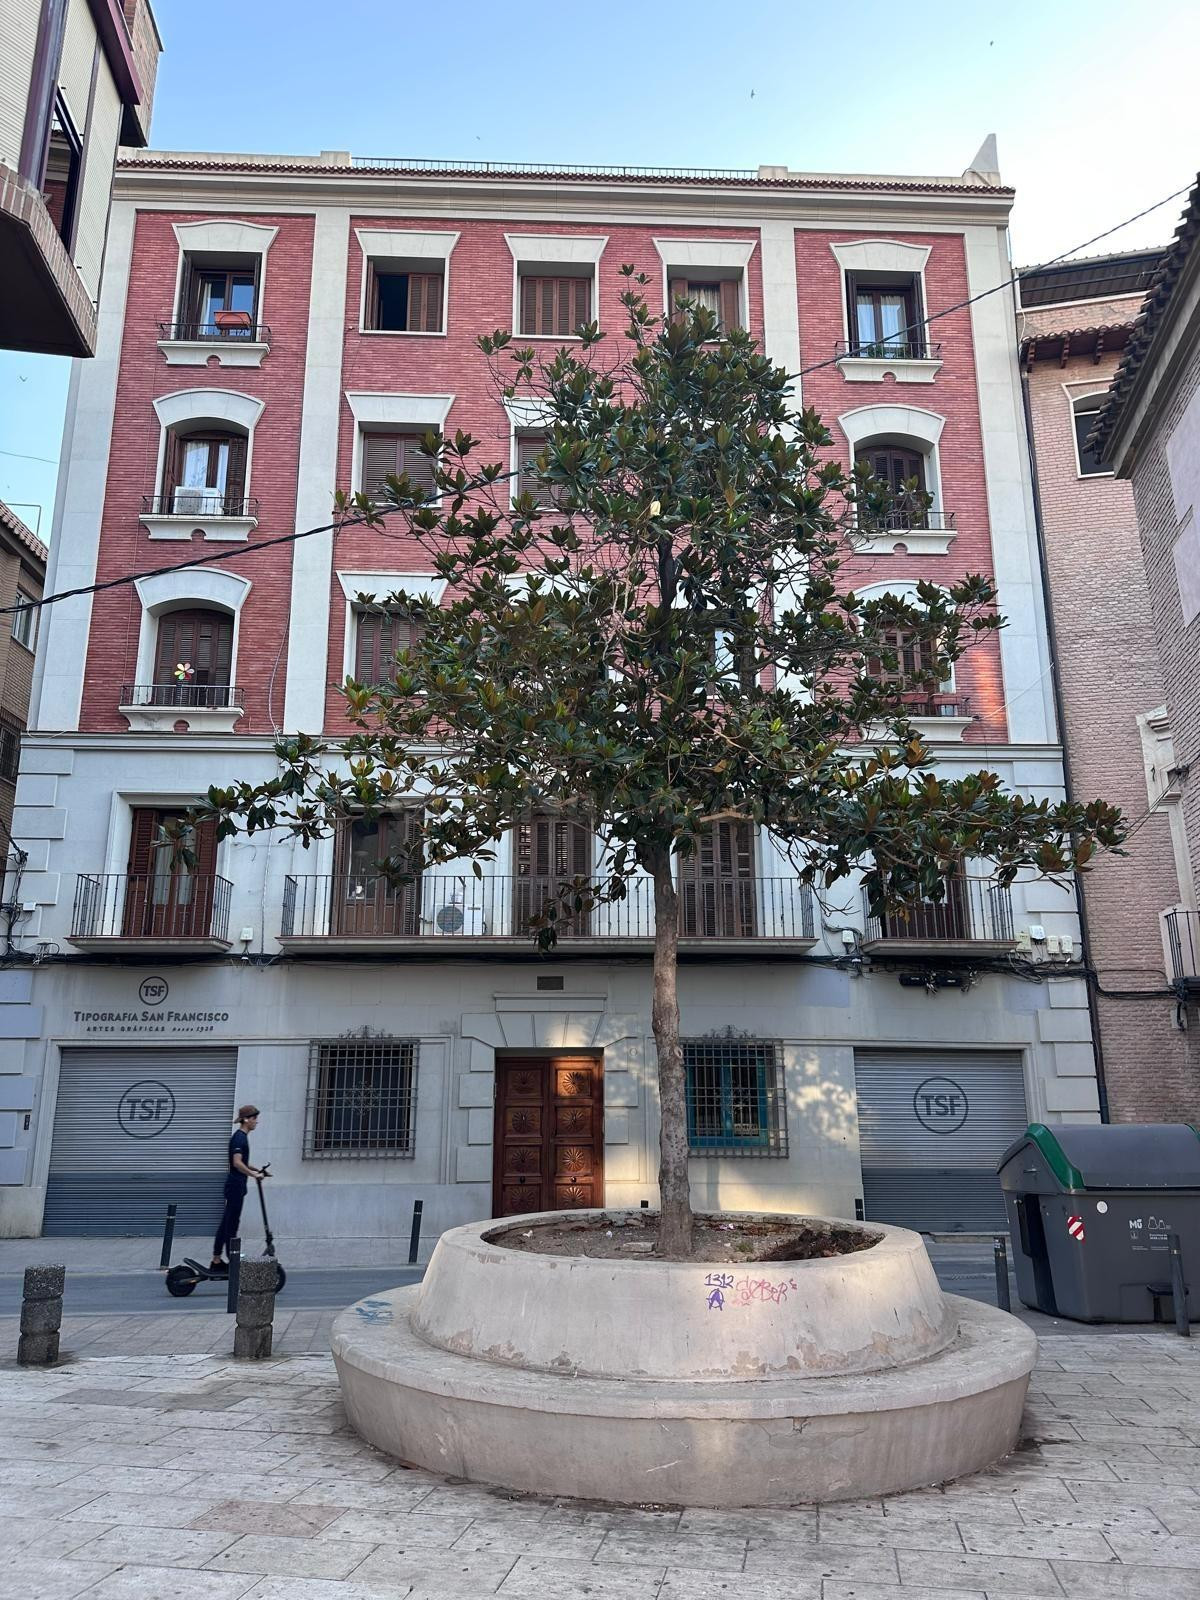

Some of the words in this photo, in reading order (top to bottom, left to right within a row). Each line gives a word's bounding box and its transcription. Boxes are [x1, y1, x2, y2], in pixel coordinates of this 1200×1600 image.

[143, 985, 165, 997] TSF
[126, 1098, 169, 1121] TSF
[920, 1095, 961, 1115] TSF
[704, 1273, 734, 1288] 1312
